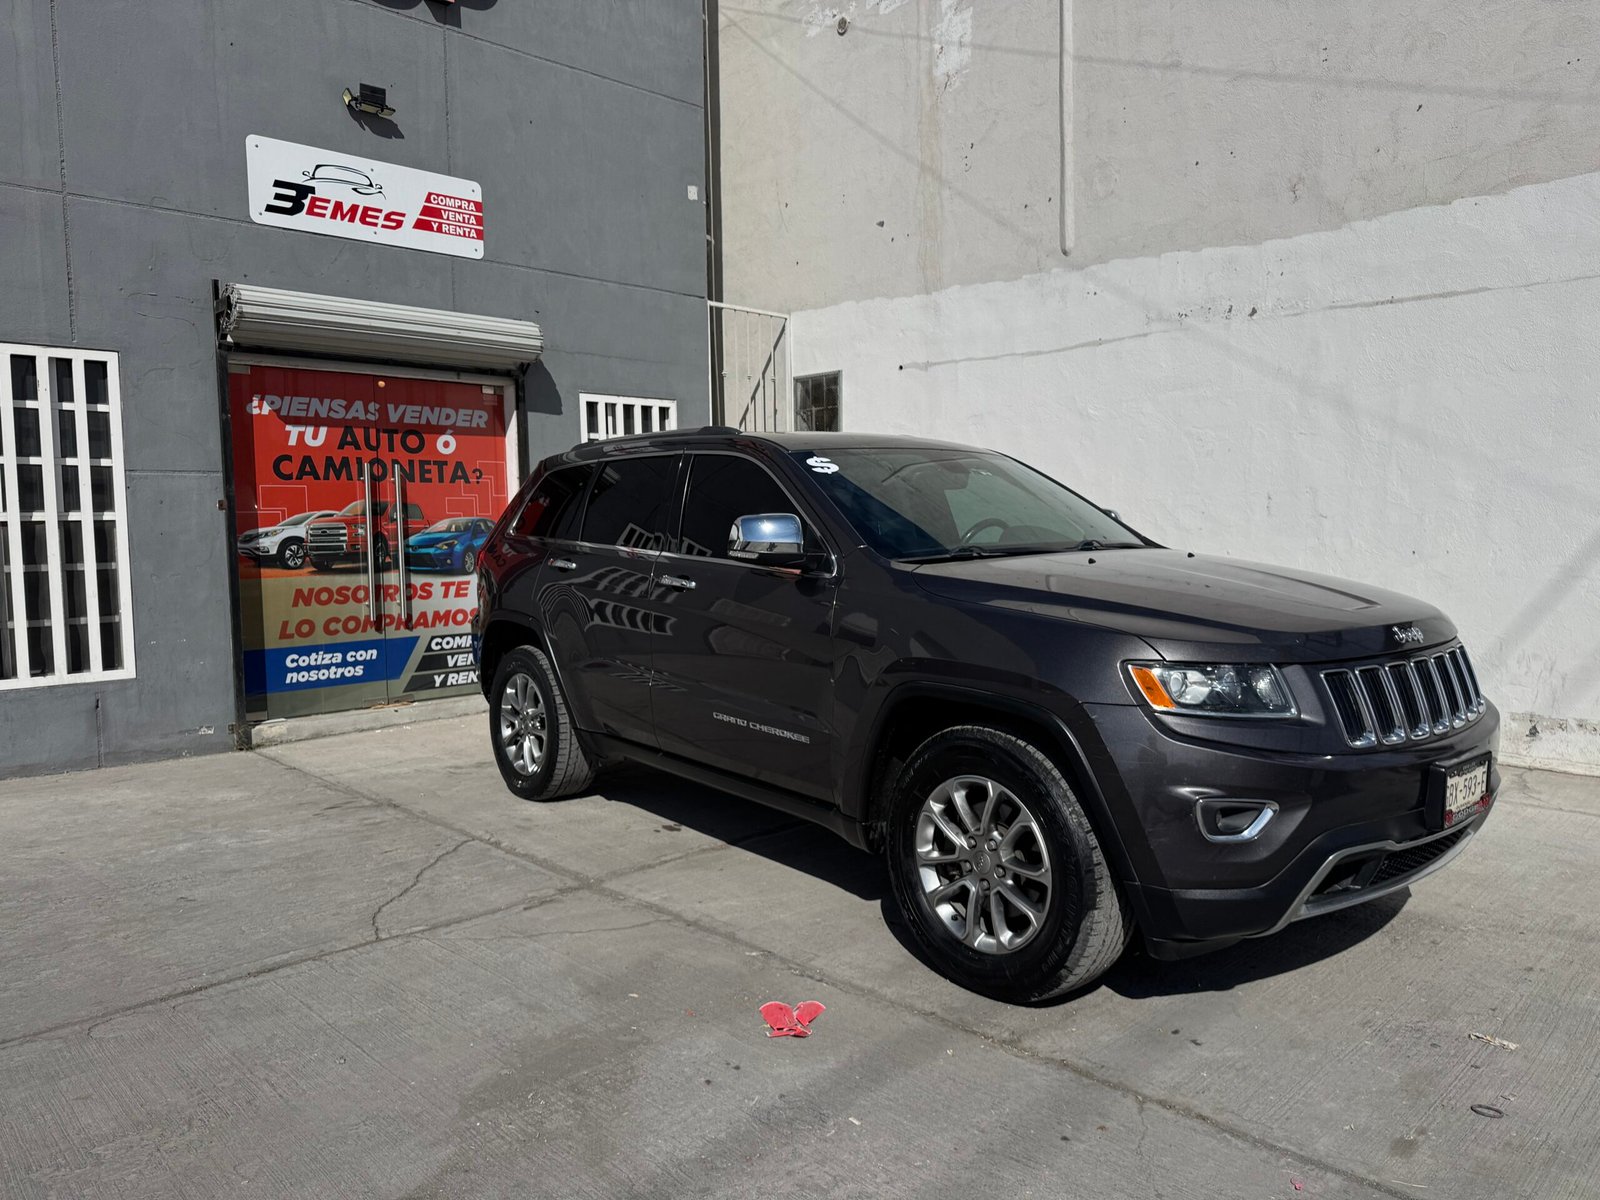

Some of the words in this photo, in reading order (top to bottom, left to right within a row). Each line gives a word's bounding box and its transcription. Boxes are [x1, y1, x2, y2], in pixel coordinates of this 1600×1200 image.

[430, 195, 476, 212] COMPRA
[441, 210, 477, 225] VENTA
[431, 222, 441, 232] Y
[442, 224, 477, 239] RENTA
[246, 394, 380, 421] ¿PIENSAS
[387, 403, 489, 429] VENDER
[285, 425, 327, 447] TU
[337, 425, 426, 454] AUTO
[292, 582, 434, 608] NOSOTROS
[440, 580, 471, 599] TE
[278, 619, 315, 640] LO
[285, 651, 342, 669] Cotiza
[346, 649, 377, 663] con
[285, 663, 364, 685] nosotros
[433, 674, 445, 687] Y
[712, 711, 747, 727] GRAND
[749, 722, 810, 744] CHEROKEE
